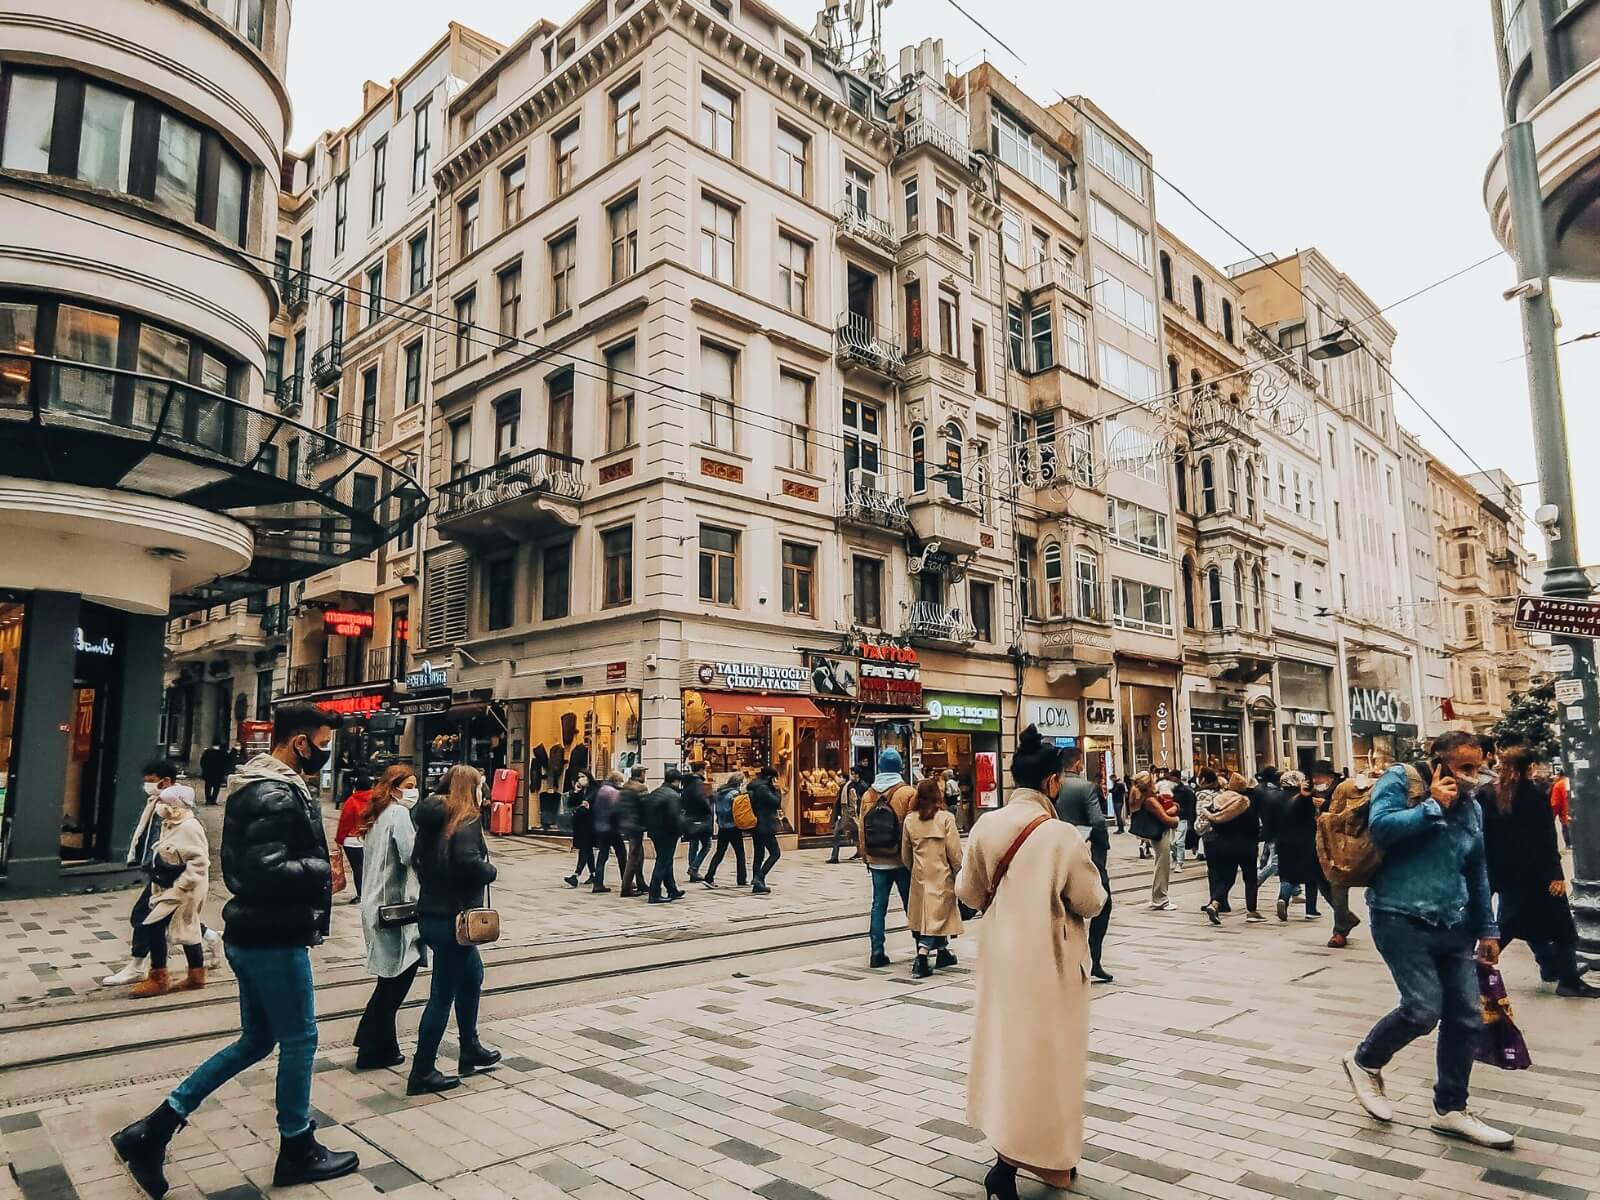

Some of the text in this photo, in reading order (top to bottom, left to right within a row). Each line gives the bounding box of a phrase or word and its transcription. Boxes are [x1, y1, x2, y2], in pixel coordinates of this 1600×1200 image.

[1540, 601, 1600, 613] Madame
[1538, 611, 1600, 624] Tussauds
[859, 643, 917, 663] TATTOO
[761, 666, 809, 680] BEYOĞLU
[1352, 687, 1399, 723] ANGO
[1037, 705, 1071, 728] LOYA
[1086, 706, 1115, 725] CAFE
